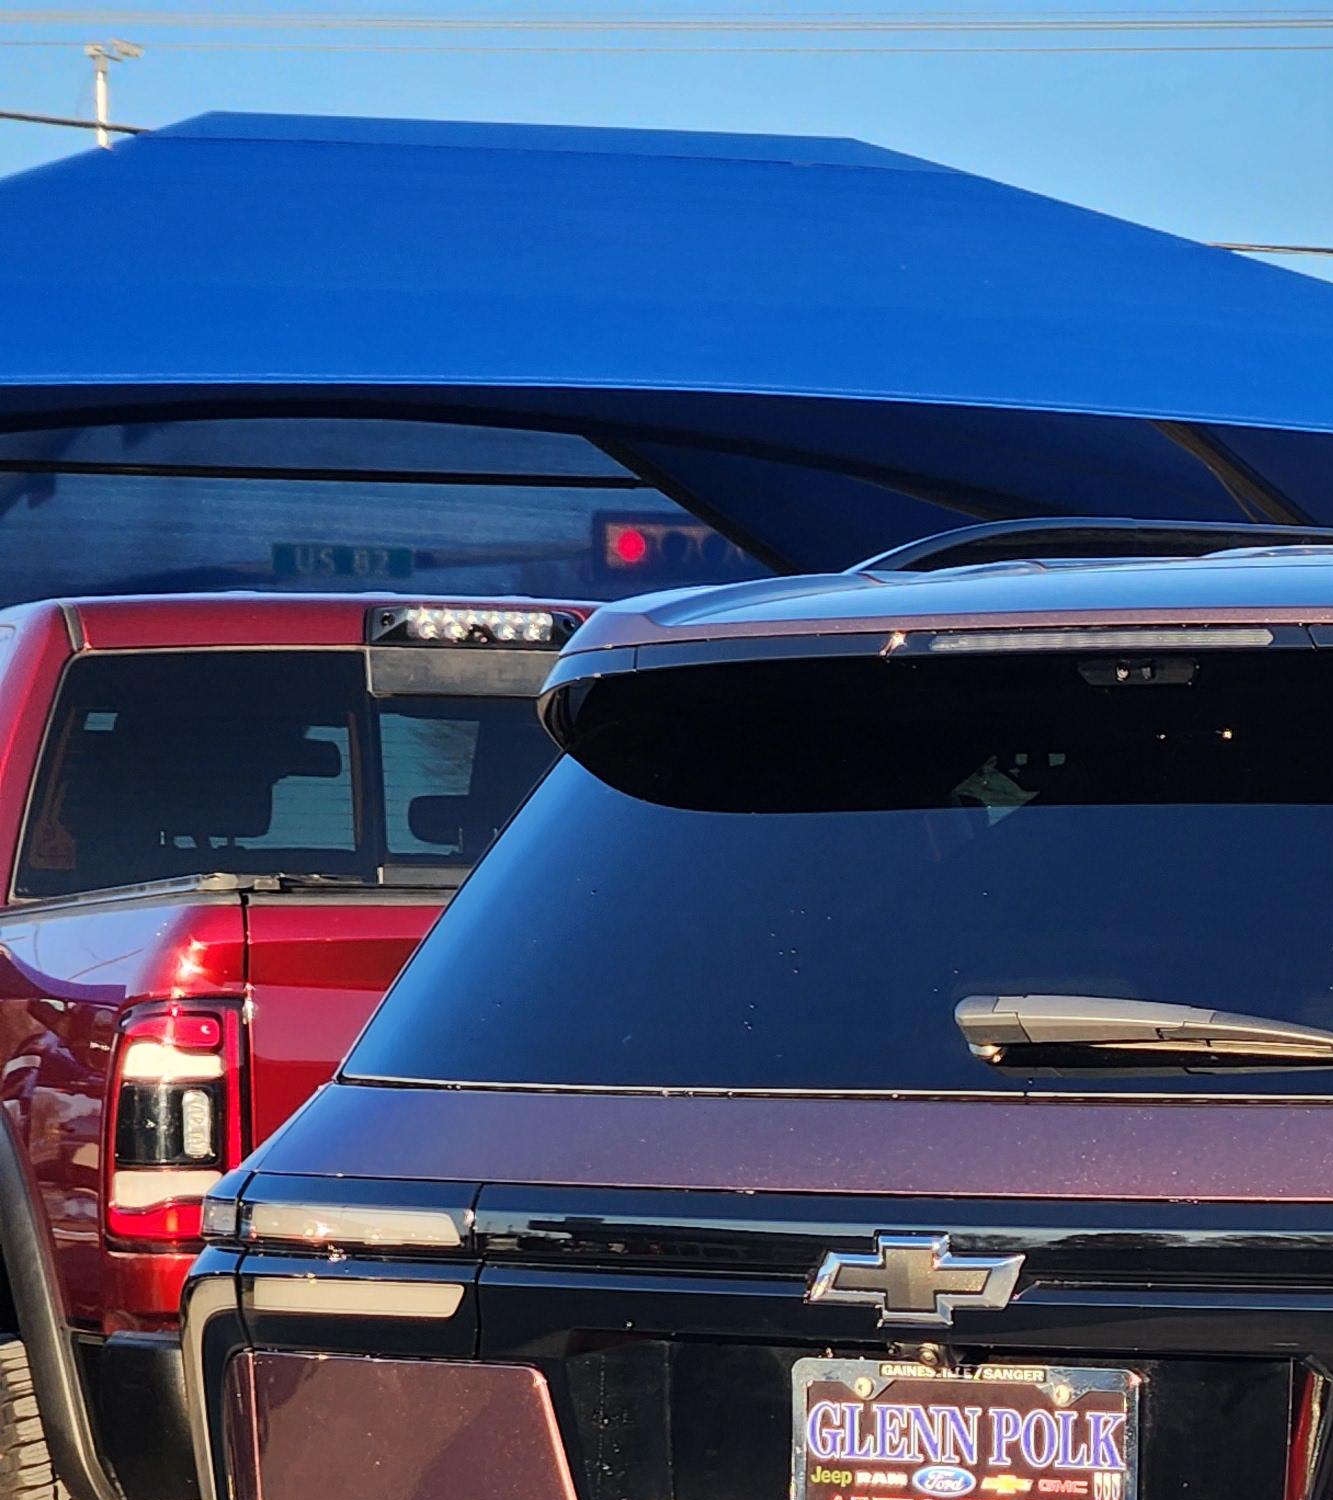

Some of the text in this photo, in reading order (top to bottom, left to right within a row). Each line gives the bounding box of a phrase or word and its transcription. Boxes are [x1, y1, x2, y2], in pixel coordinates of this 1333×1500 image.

[295, 546, 336, 576] US
[807, 1400, 1127, 1471] GLENN POLK
[811, 1465, 1089, 1495] Jeep RAM Ford GMC
